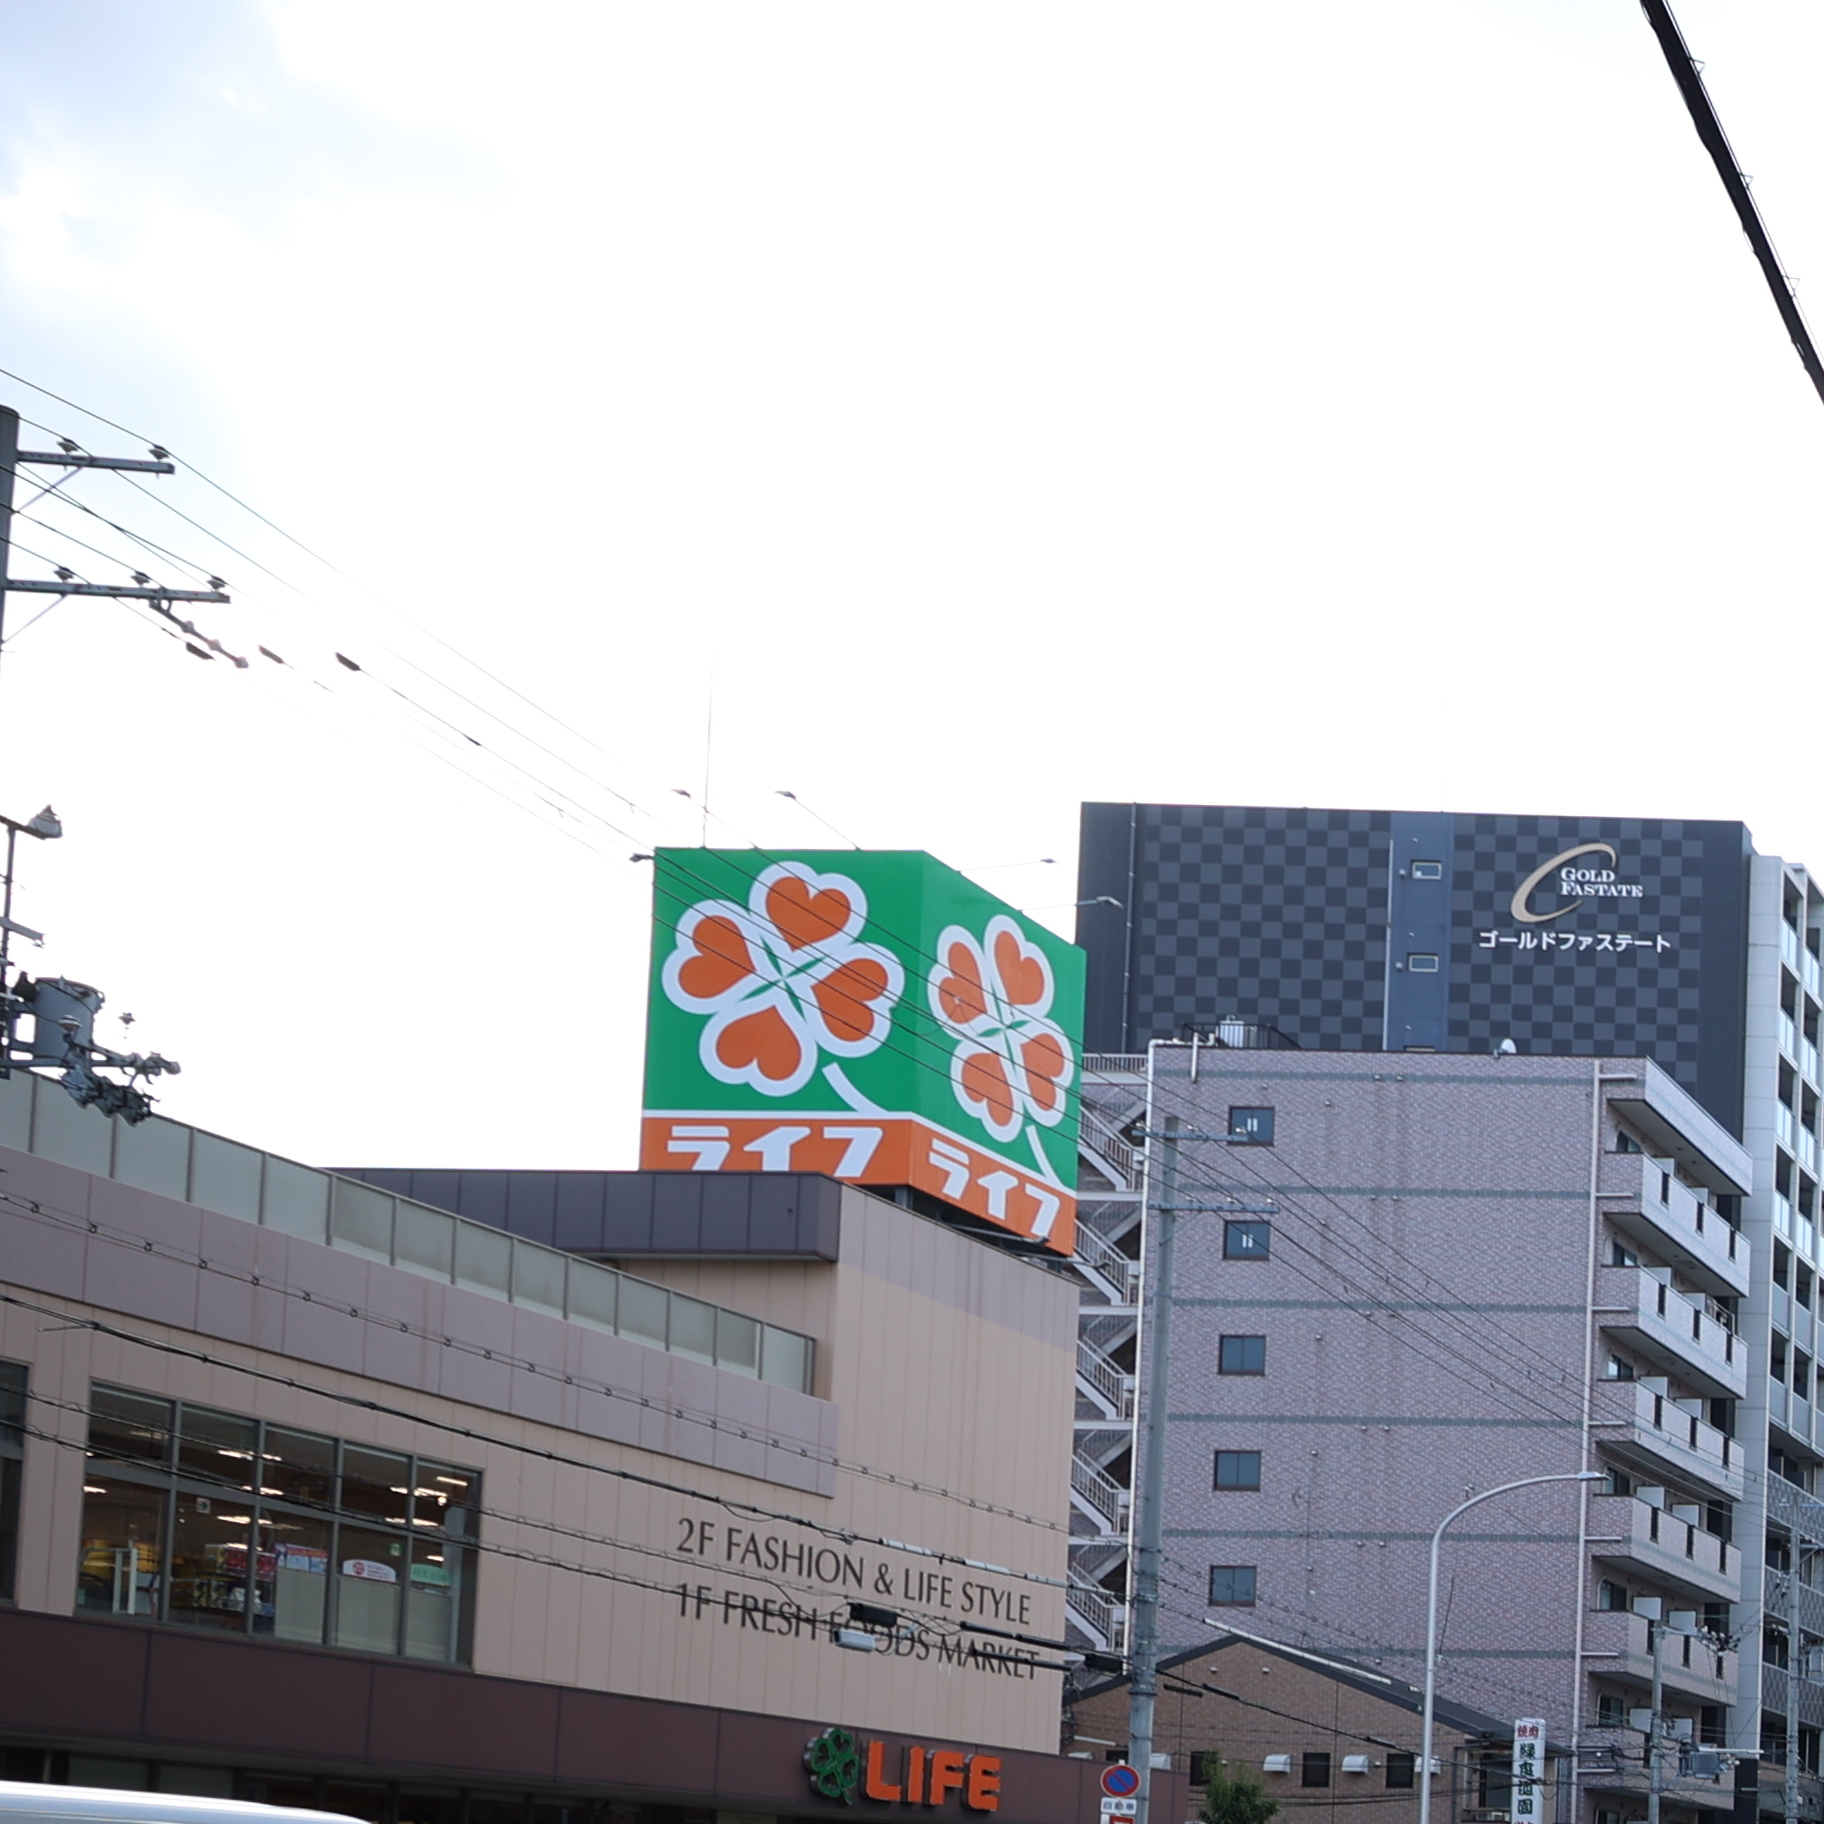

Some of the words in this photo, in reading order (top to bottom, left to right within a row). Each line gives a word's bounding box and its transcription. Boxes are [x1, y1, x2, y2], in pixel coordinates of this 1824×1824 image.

[1560, 866, 1616, 883] GOLD
[1560, 881, 1643, 899] FASTATE
[1479, 930, 1671, 953] ゴールドファステート
[667, 1125, 883, 1178] ライフ
[929, 1138, 1060, 1242] ライフ
[677, 1517, 715, 1557] 2F
[726, 1527, 866, 1590] FASHION
[874, 1563, 894, 1596] &
[903, 1569, 953, 1611] LIFE
[961, 1581, 1032, 1626] STYLE
[677, 1581, 714, 1622] 1F
[724, 1589, 818, 1641] FRESH
[939, 1637, 1040, 1681] MARKET
[866, 1740, 1002, 1812] LIFE
